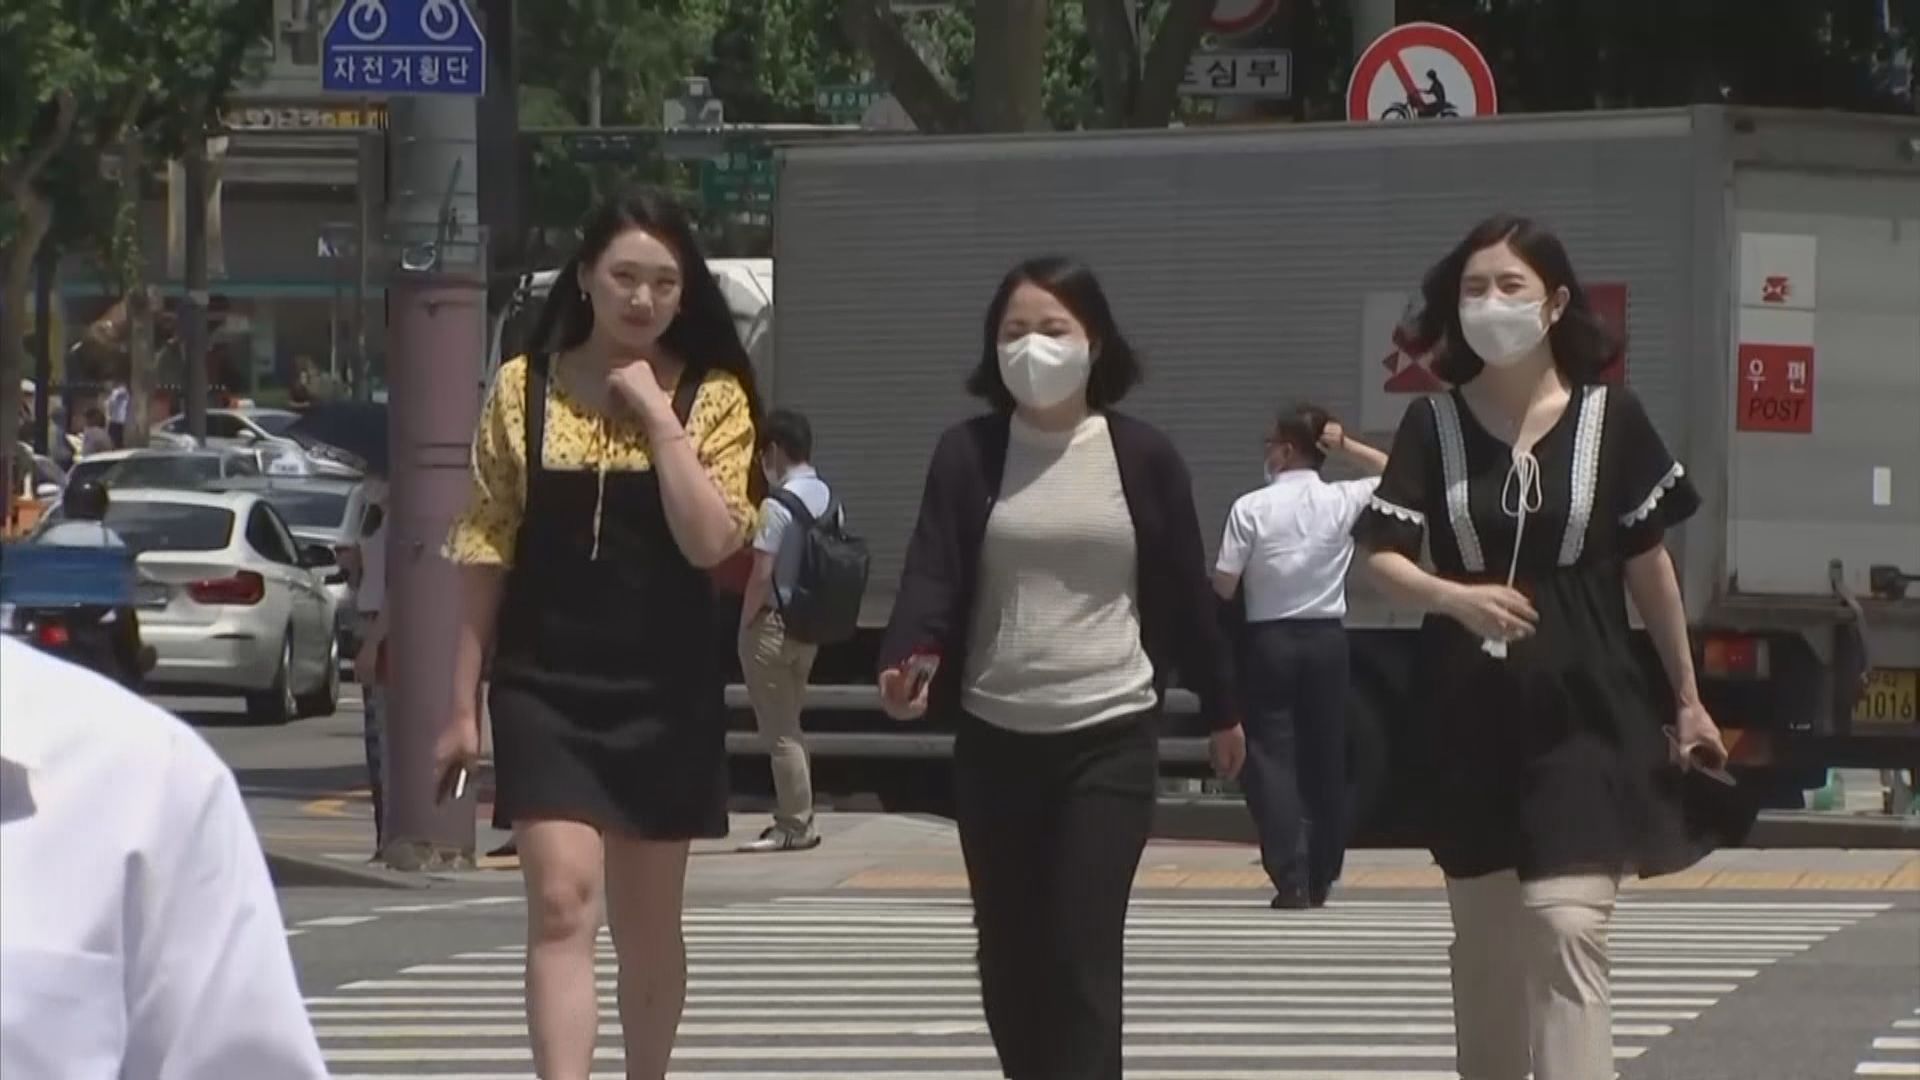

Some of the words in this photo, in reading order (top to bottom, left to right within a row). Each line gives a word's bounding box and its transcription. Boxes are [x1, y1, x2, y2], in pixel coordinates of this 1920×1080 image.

[334, 54, 468, 85] 자전거횡단
[1747, 359, 1806, 393] 우편
[1748, 398, 1804, 421] POST
